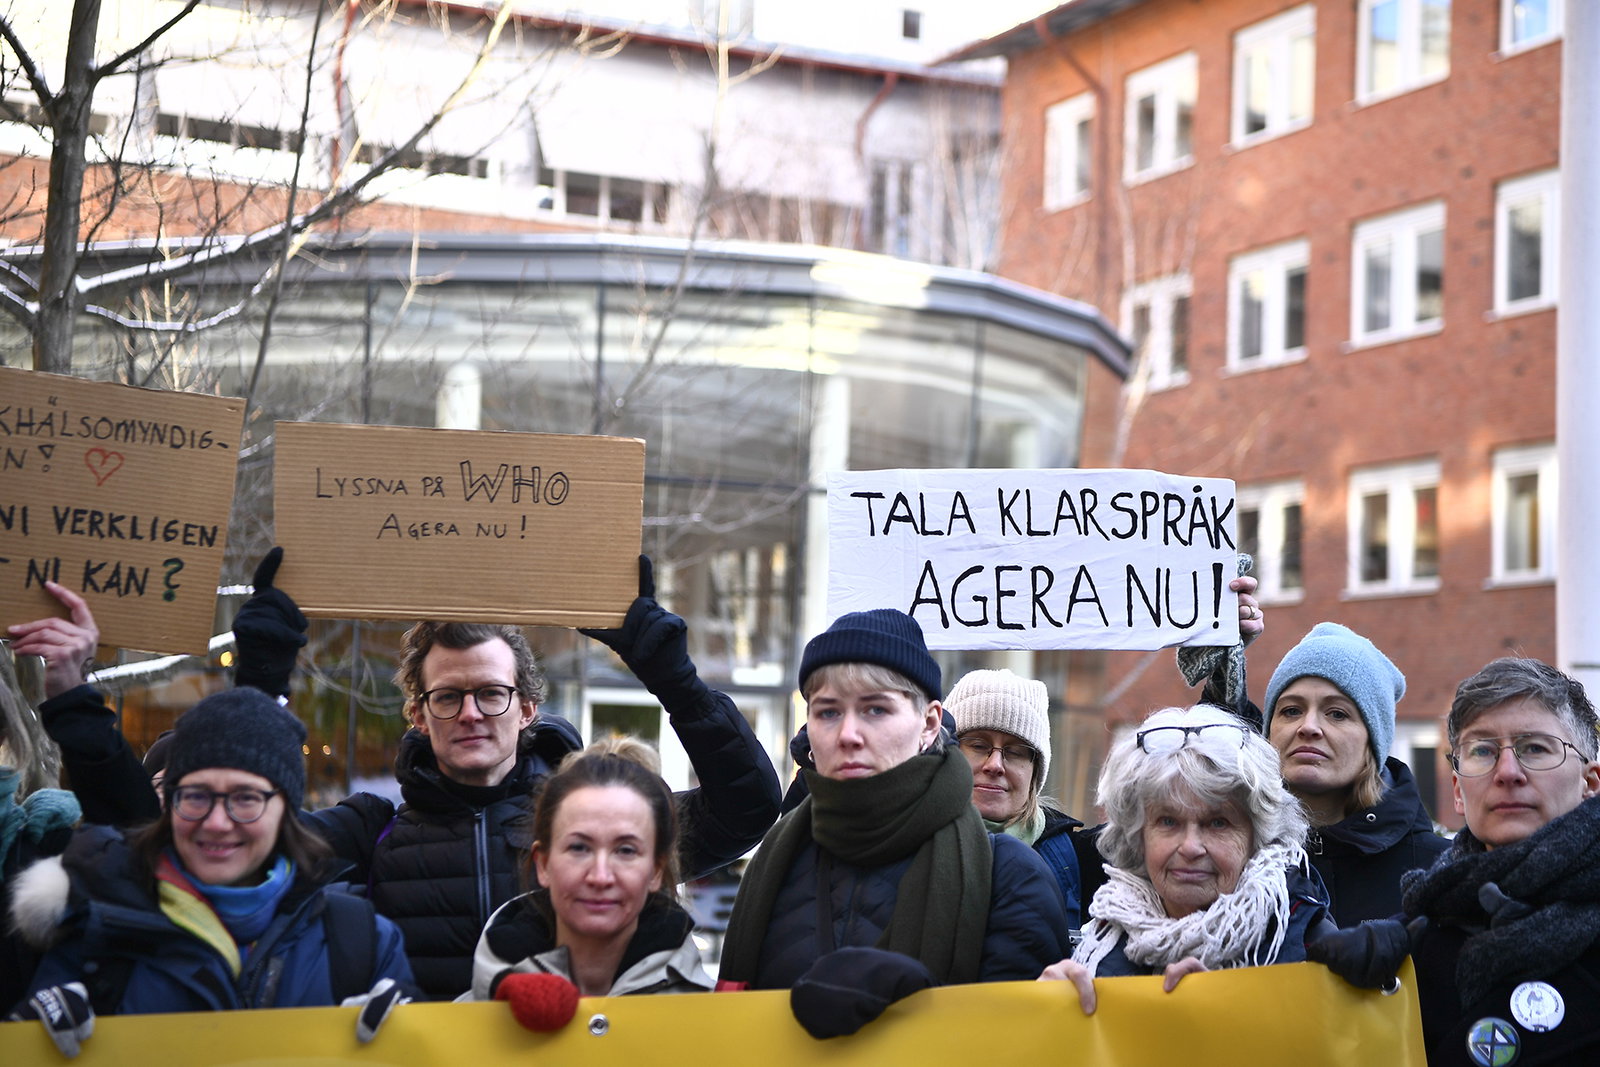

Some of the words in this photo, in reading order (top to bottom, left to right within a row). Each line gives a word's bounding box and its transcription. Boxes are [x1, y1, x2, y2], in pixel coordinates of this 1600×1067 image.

[459, 460, 570, 505] WHO
[53, 506, 218, 547] VERKLIGEN
[850, 491, 976, 536] TALA
[998, 484, 1236, 550] KLARSPRÅK
[25, 557, 61, 589] NI
[909, 560, 1109, 629] AGERA
[1126, 562, 1223, 630] NU!
